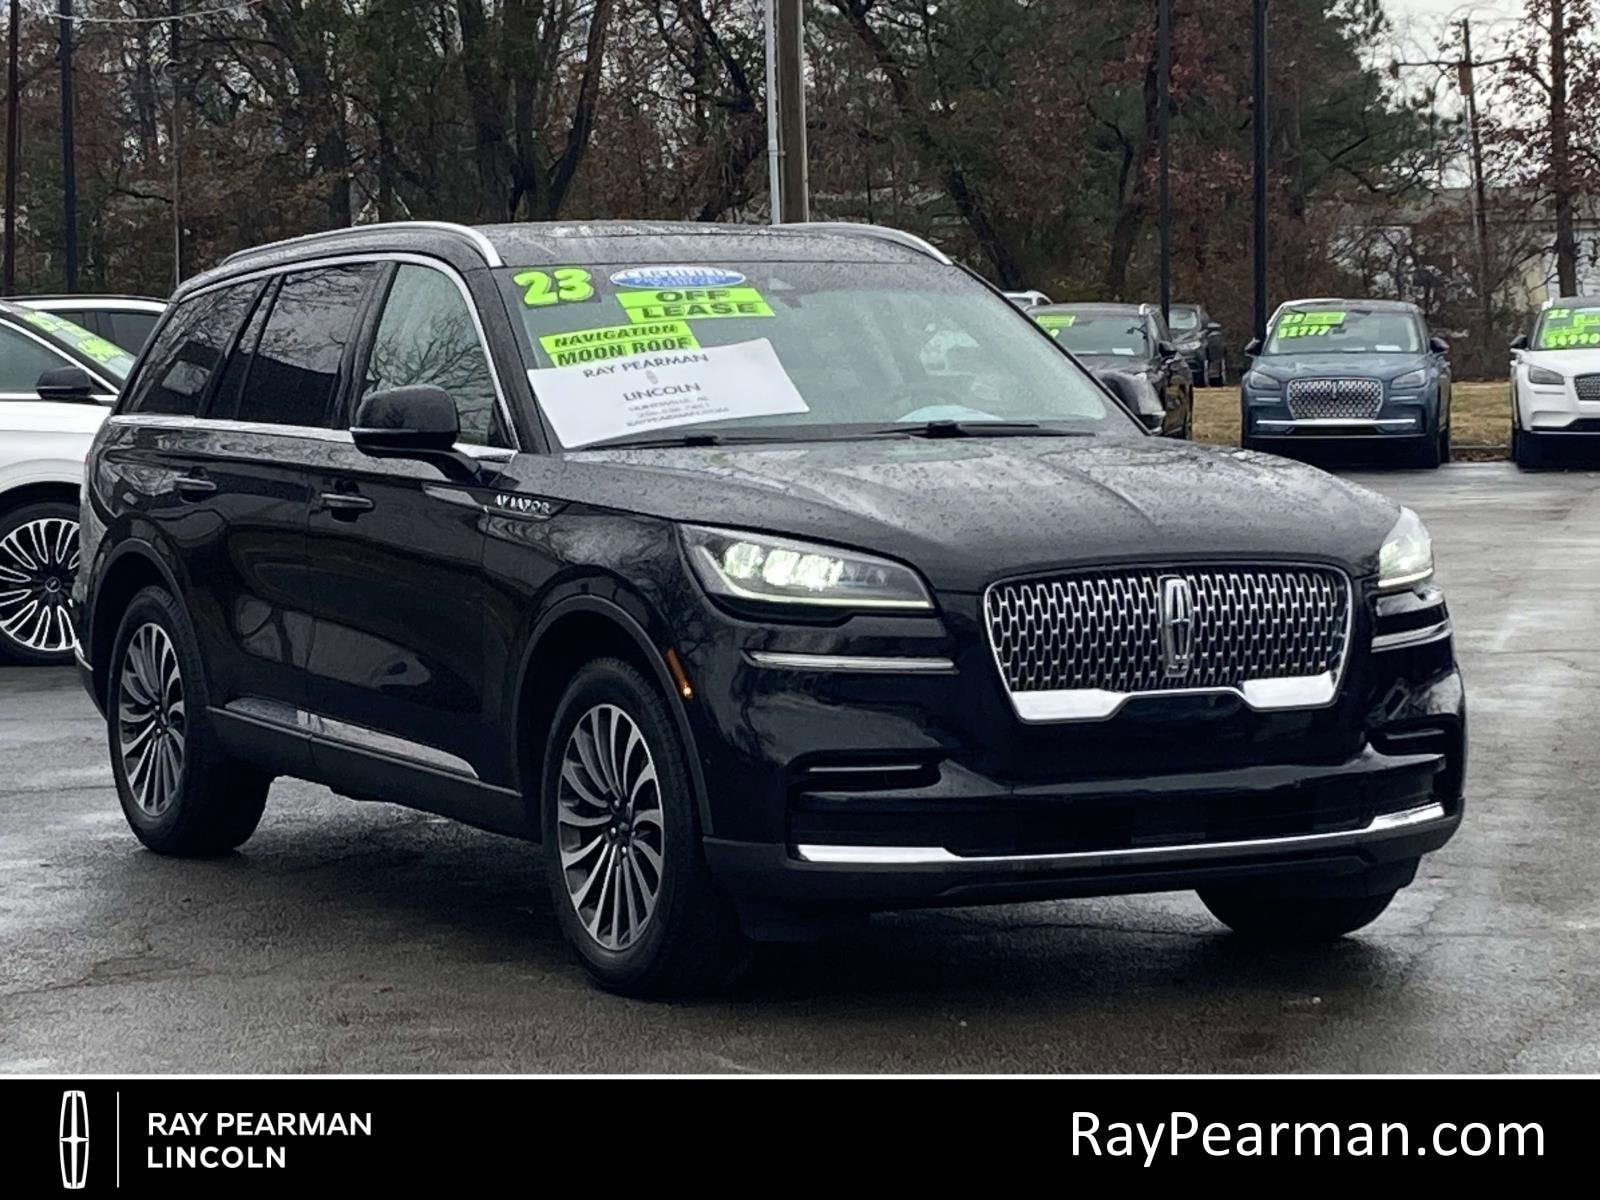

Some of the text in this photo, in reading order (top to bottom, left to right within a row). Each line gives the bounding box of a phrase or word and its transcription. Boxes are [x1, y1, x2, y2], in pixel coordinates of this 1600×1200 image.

[513, 268, 594, 304] 23
[655, 290, 728, 302] OFF
[642, 302, 757, 319] LEASE
[554, 324, 678, 348] NAVIGATION
[557, 336, 690, 367] MOON ROOF
[583, 354, 709, 379] RAY PEARMAN
[623, 382, 702, 402] LINCOLN
[495, 494, 550, 514] AVIATOR
